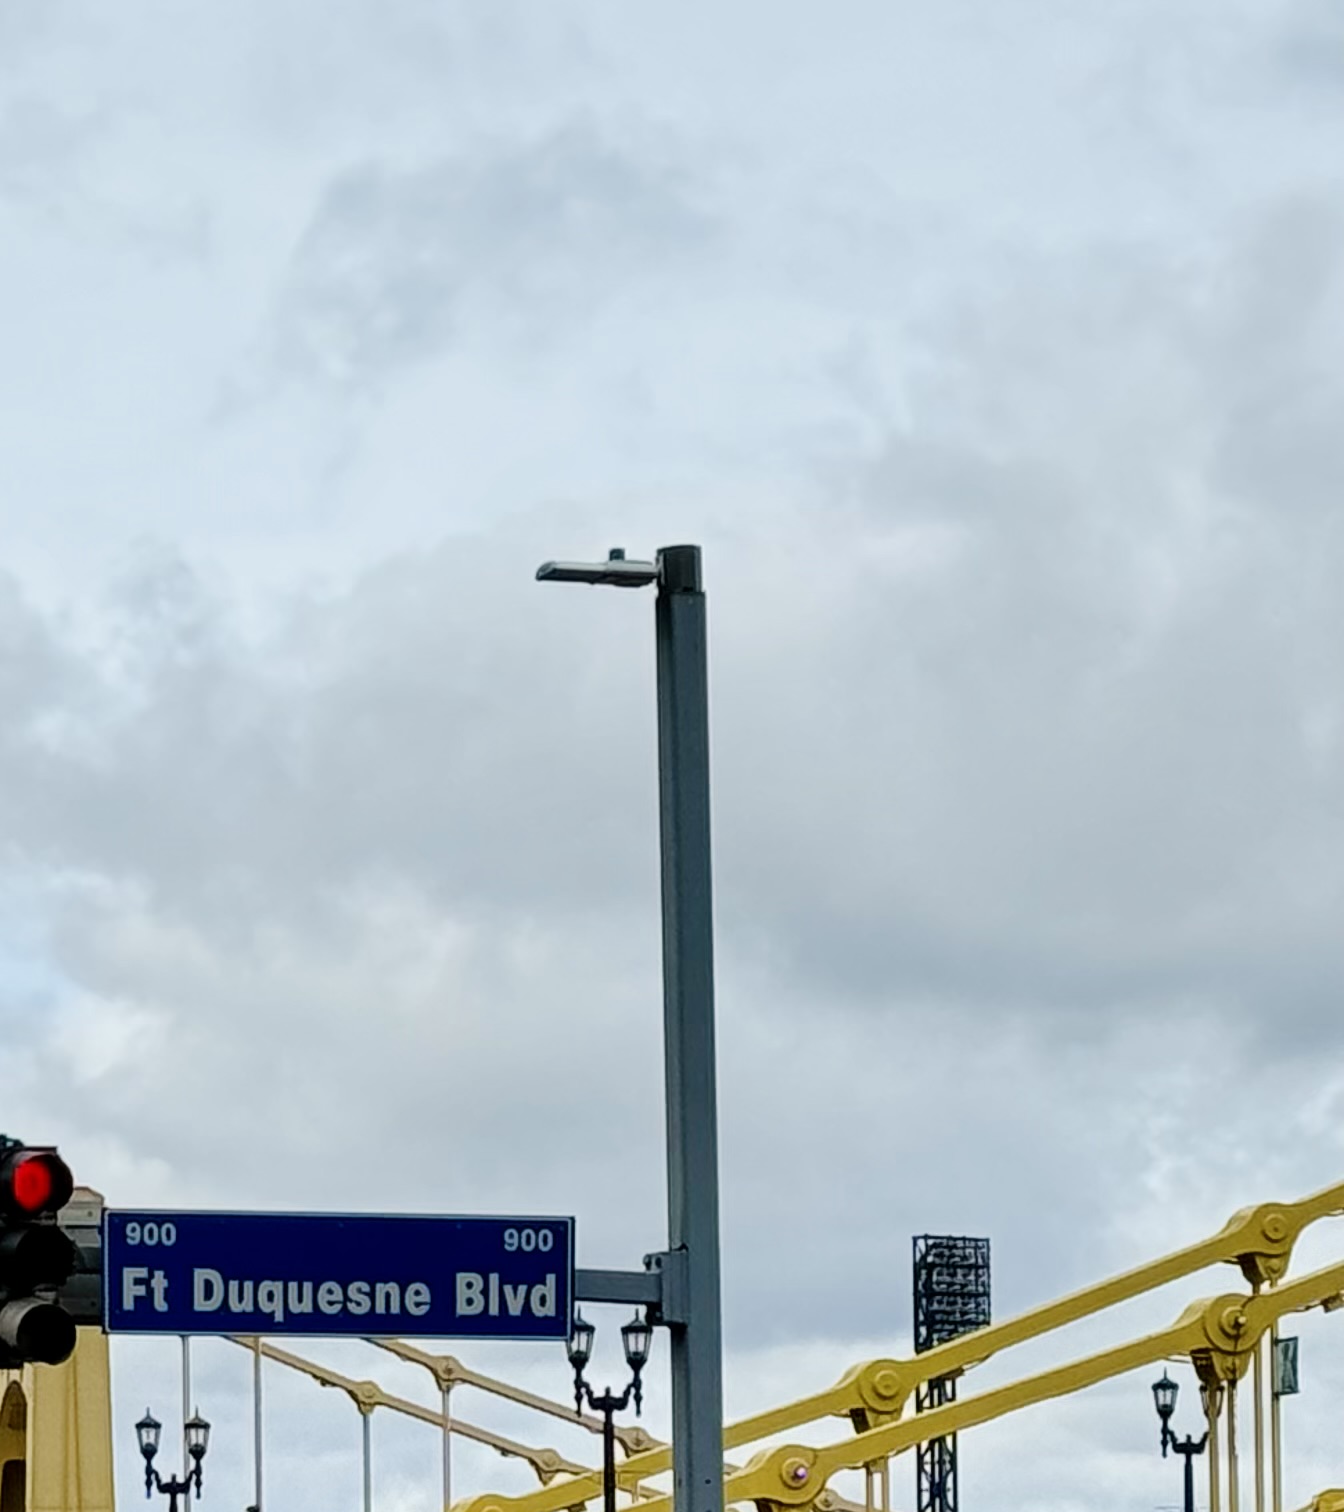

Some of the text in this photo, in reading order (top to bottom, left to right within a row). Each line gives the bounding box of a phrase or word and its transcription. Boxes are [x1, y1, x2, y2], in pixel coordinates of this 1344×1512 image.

[125, 1222, 177, 1247] 900
[503, 1228, 554, 1253] 900
[121, 1266, 558, 1323] Ft Duquesne Blvd
